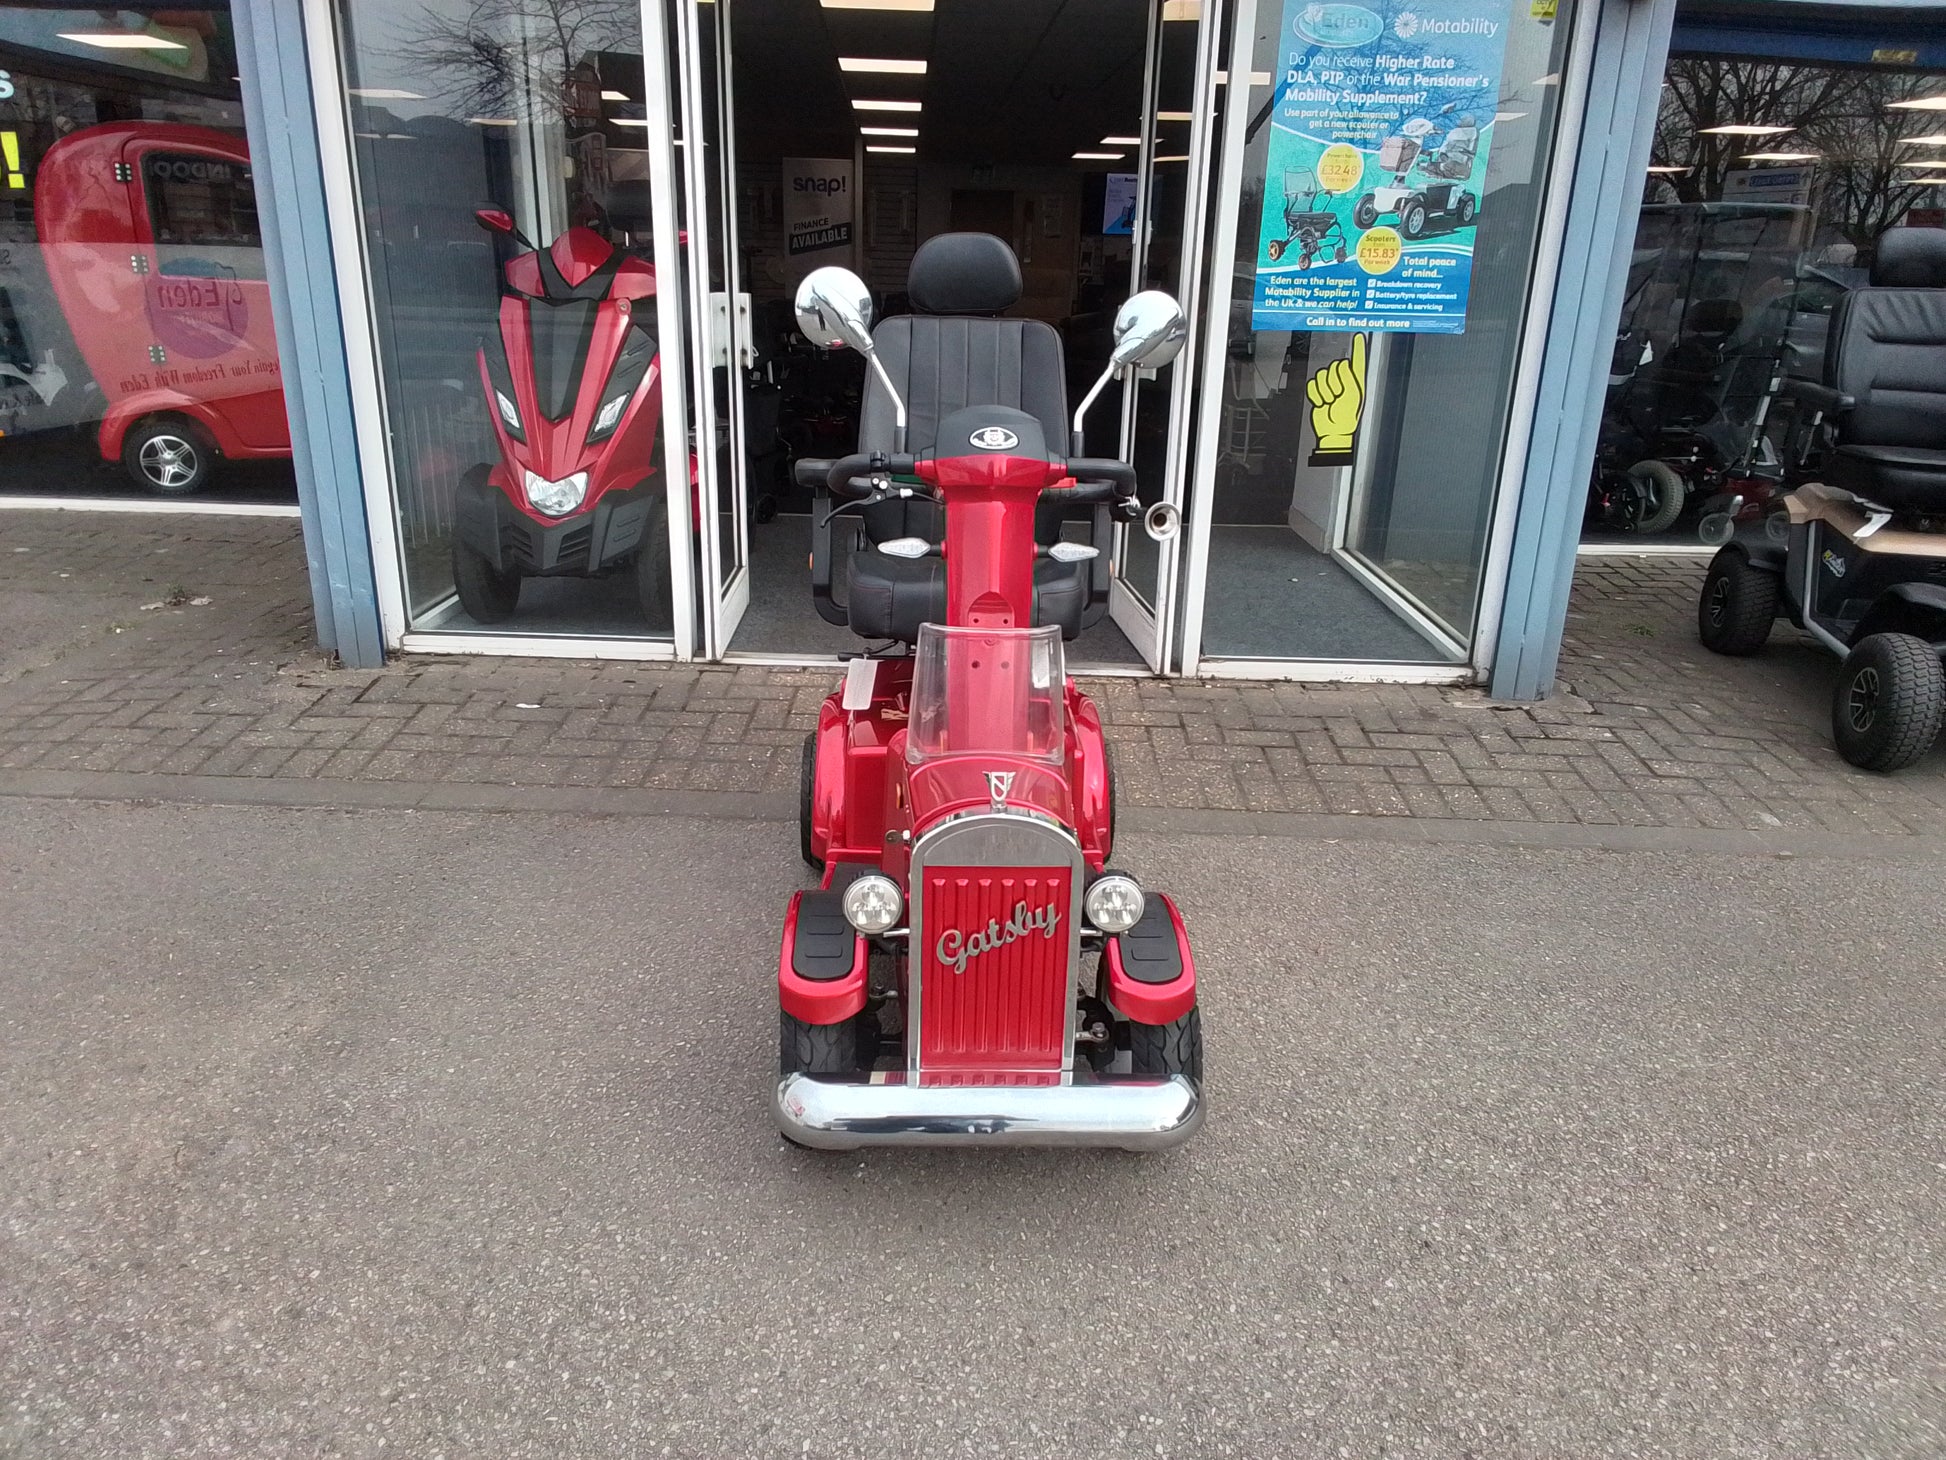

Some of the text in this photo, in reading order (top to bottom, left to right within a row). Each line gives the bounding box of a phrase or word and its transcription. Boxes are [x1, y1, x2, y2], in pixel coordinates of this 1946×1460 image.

[1420, 18, 1498, 37] Motability
[1289, 52, 1455, 71] Do you receive Higher Rate
[1287, 70, 1489, 88] DLA, PIP or the War Pensioner's
[1285, 88, 1427, 106] Mobility Supplement?
[1284, 108, 1300, 118] Use
[1300, 109, 1318, 120] part
[1319, 109, 1330, 118] of
[1329, 111, 1348, 121] your
[1348, 110, 1389, 120] allowance
[1309, 120, 1323, 130] get
[1331, 121, 1348, 129] new
[1332, 130, 1378, 140] powerchair
[792, 175, 847, 197] snap!
[793, 217, 829, 232] FINANCE
[792, 227, 848, 249] AVAILABLE
[1366, 234, 1397, 243] Scooters
[1402, 256, 1457, 268] Total peace
[1402, 268, 1413, 277] of
[1270, 275, 1292, 285] Eden
[1309, 276, 1323, 285] the
[1326, 276, 1358, 287] largest
[1376, 280, 1442, 290] Breakdown recovery
[1265, 286, 1360, 299] Motability Supplier in
[1416, 292, 1458, 301] replacement
[1265, 298, 1280, 307] the
[1281, 298, 1294, 307] UK
[1294, 299, 1303, 307] &
[1304, 300, 1317, 308] we
[1335, 299, 1358, 311] help!
[1374, 302, 1406, 310] Insurance
[1413, 302, 1443, 312] servicing
[1306, 317, 1324, 326] Call
[1325, 318, 1335, 326] in
[1336, 318, 1347, 326] to
[1348, 317, 1367, 327] find
[1368, 318, 1385, 327] out
[1386, 320, 1411, 328] more
[936, 900, 1062, 975] Gatsby
